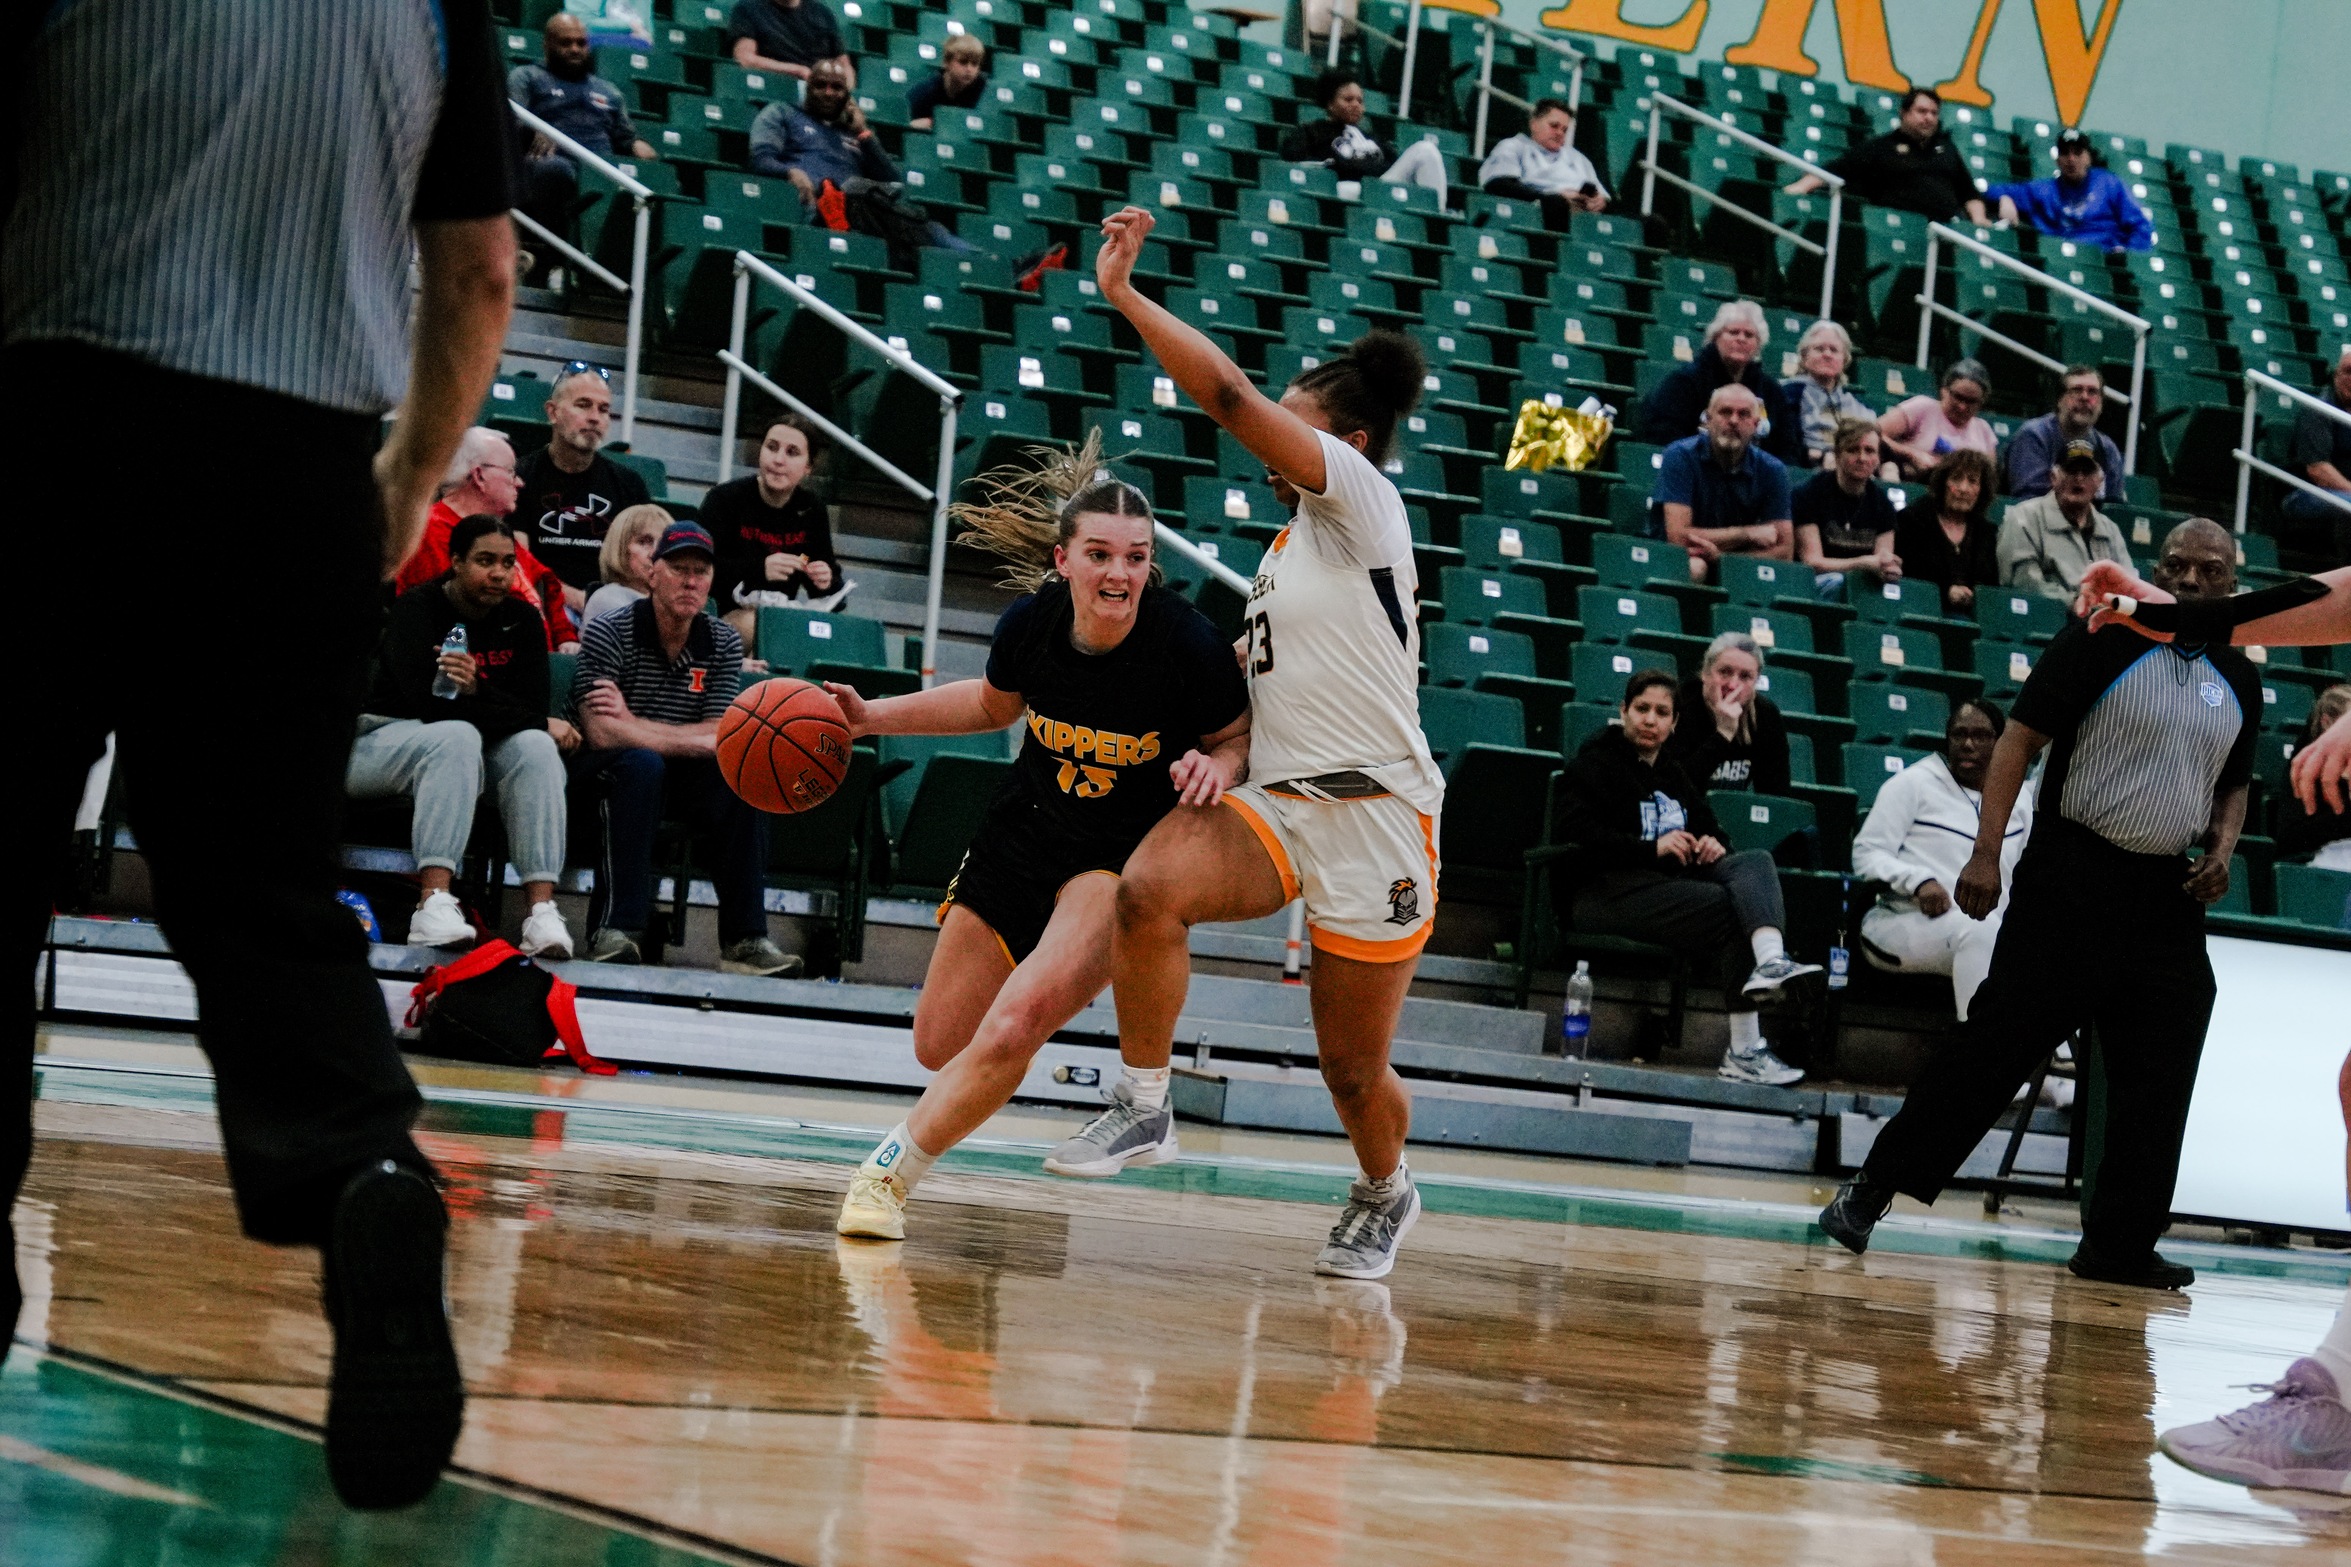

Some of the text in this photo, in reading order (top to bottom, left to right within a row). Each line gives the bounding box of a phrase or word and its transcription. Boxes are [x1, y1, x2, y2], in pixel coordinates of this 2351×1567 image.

[539, 535, 571, 546] UNDER
[1027, 704, 1160, 767] KIPPERS
[1050, 756, 1117, 798] 15
